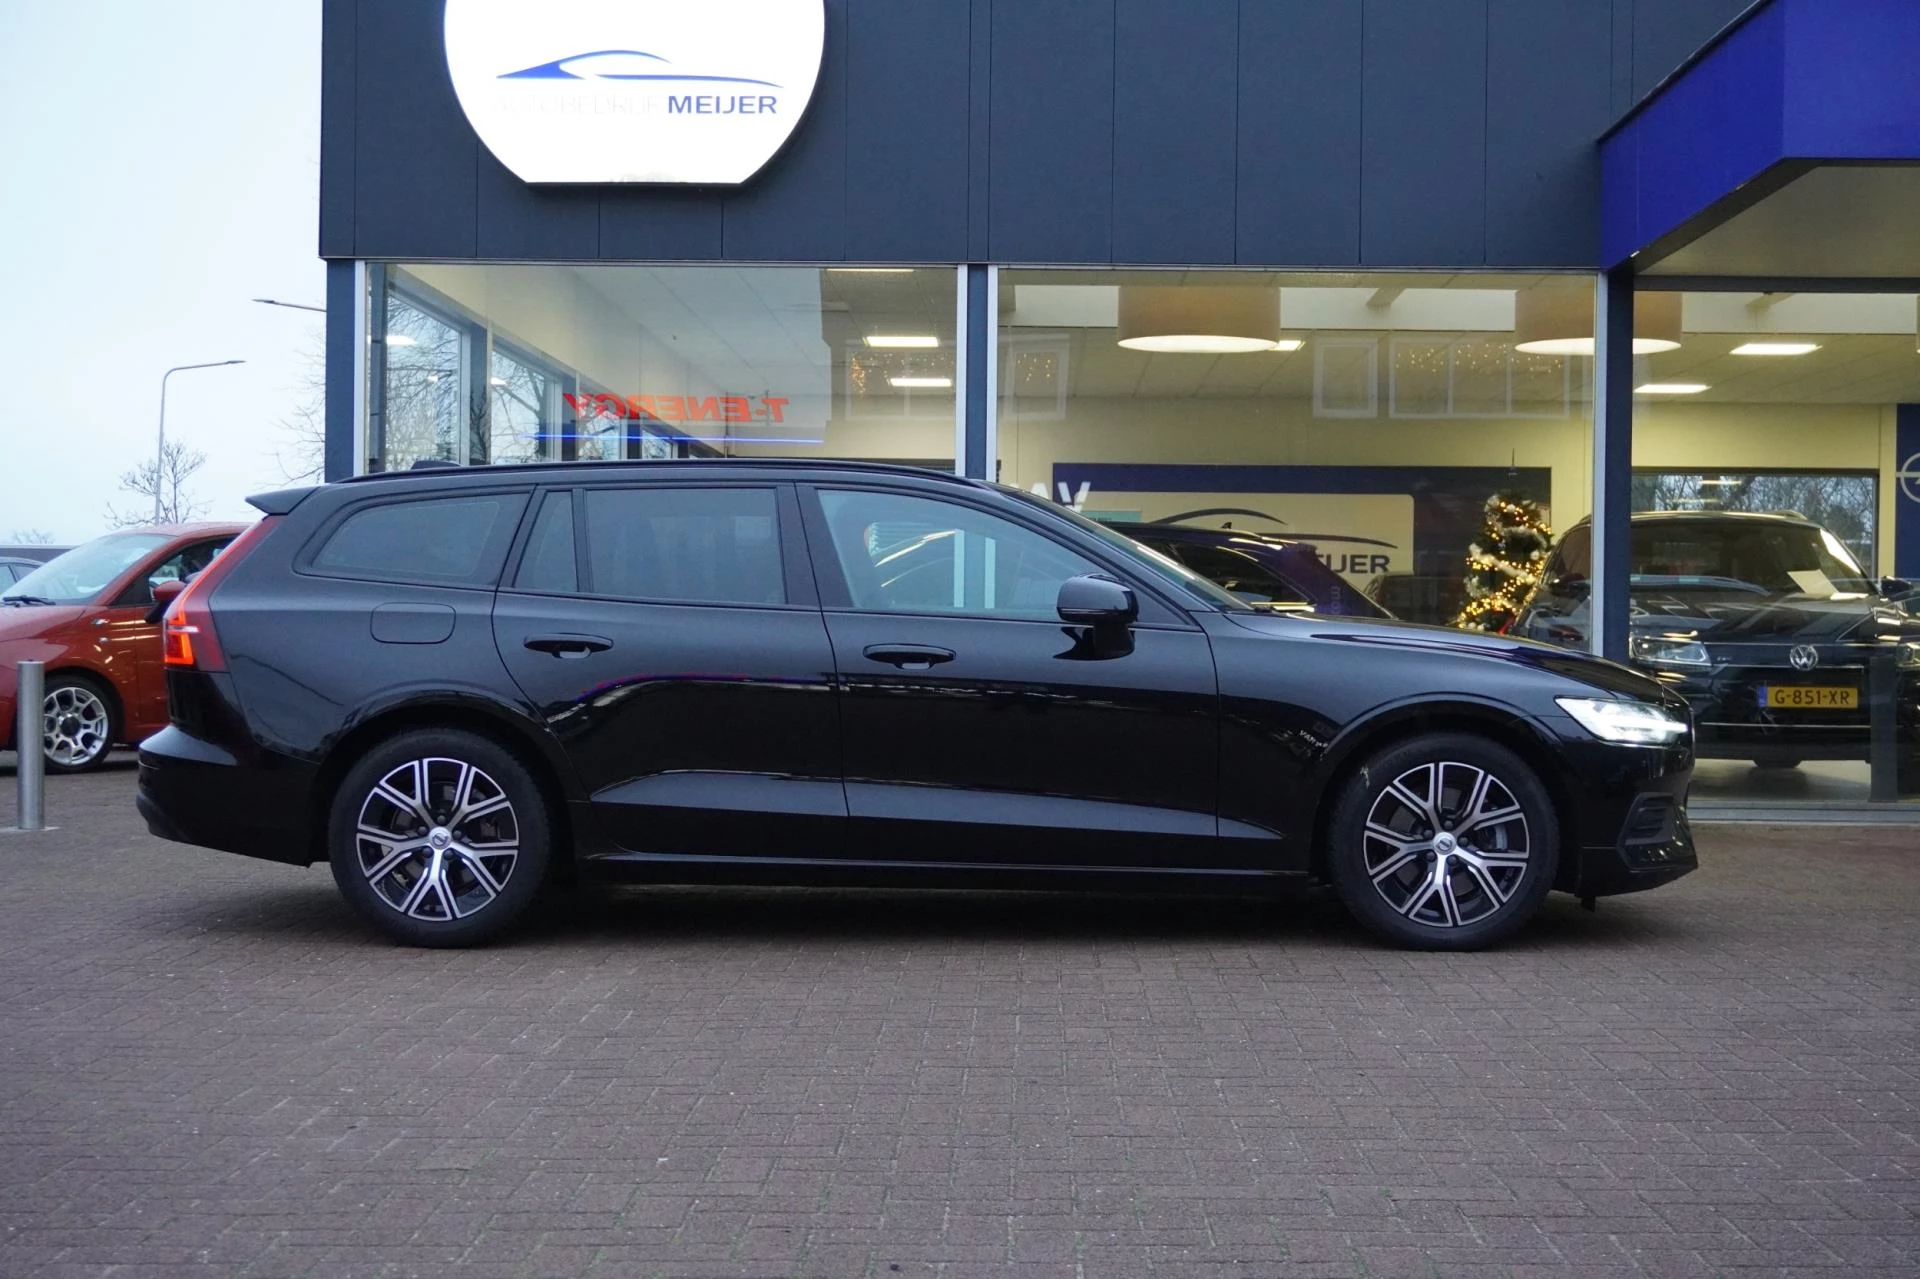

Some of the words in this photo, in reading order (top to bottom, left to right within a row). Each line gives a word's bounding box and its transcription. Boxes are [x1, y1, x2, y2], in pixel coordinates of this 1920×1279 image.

[668, 95, 777, 114] MEIJER
[1316, 554, 1390, 574] IJER
[1775, 689, 1849, 705] G-851-XR
